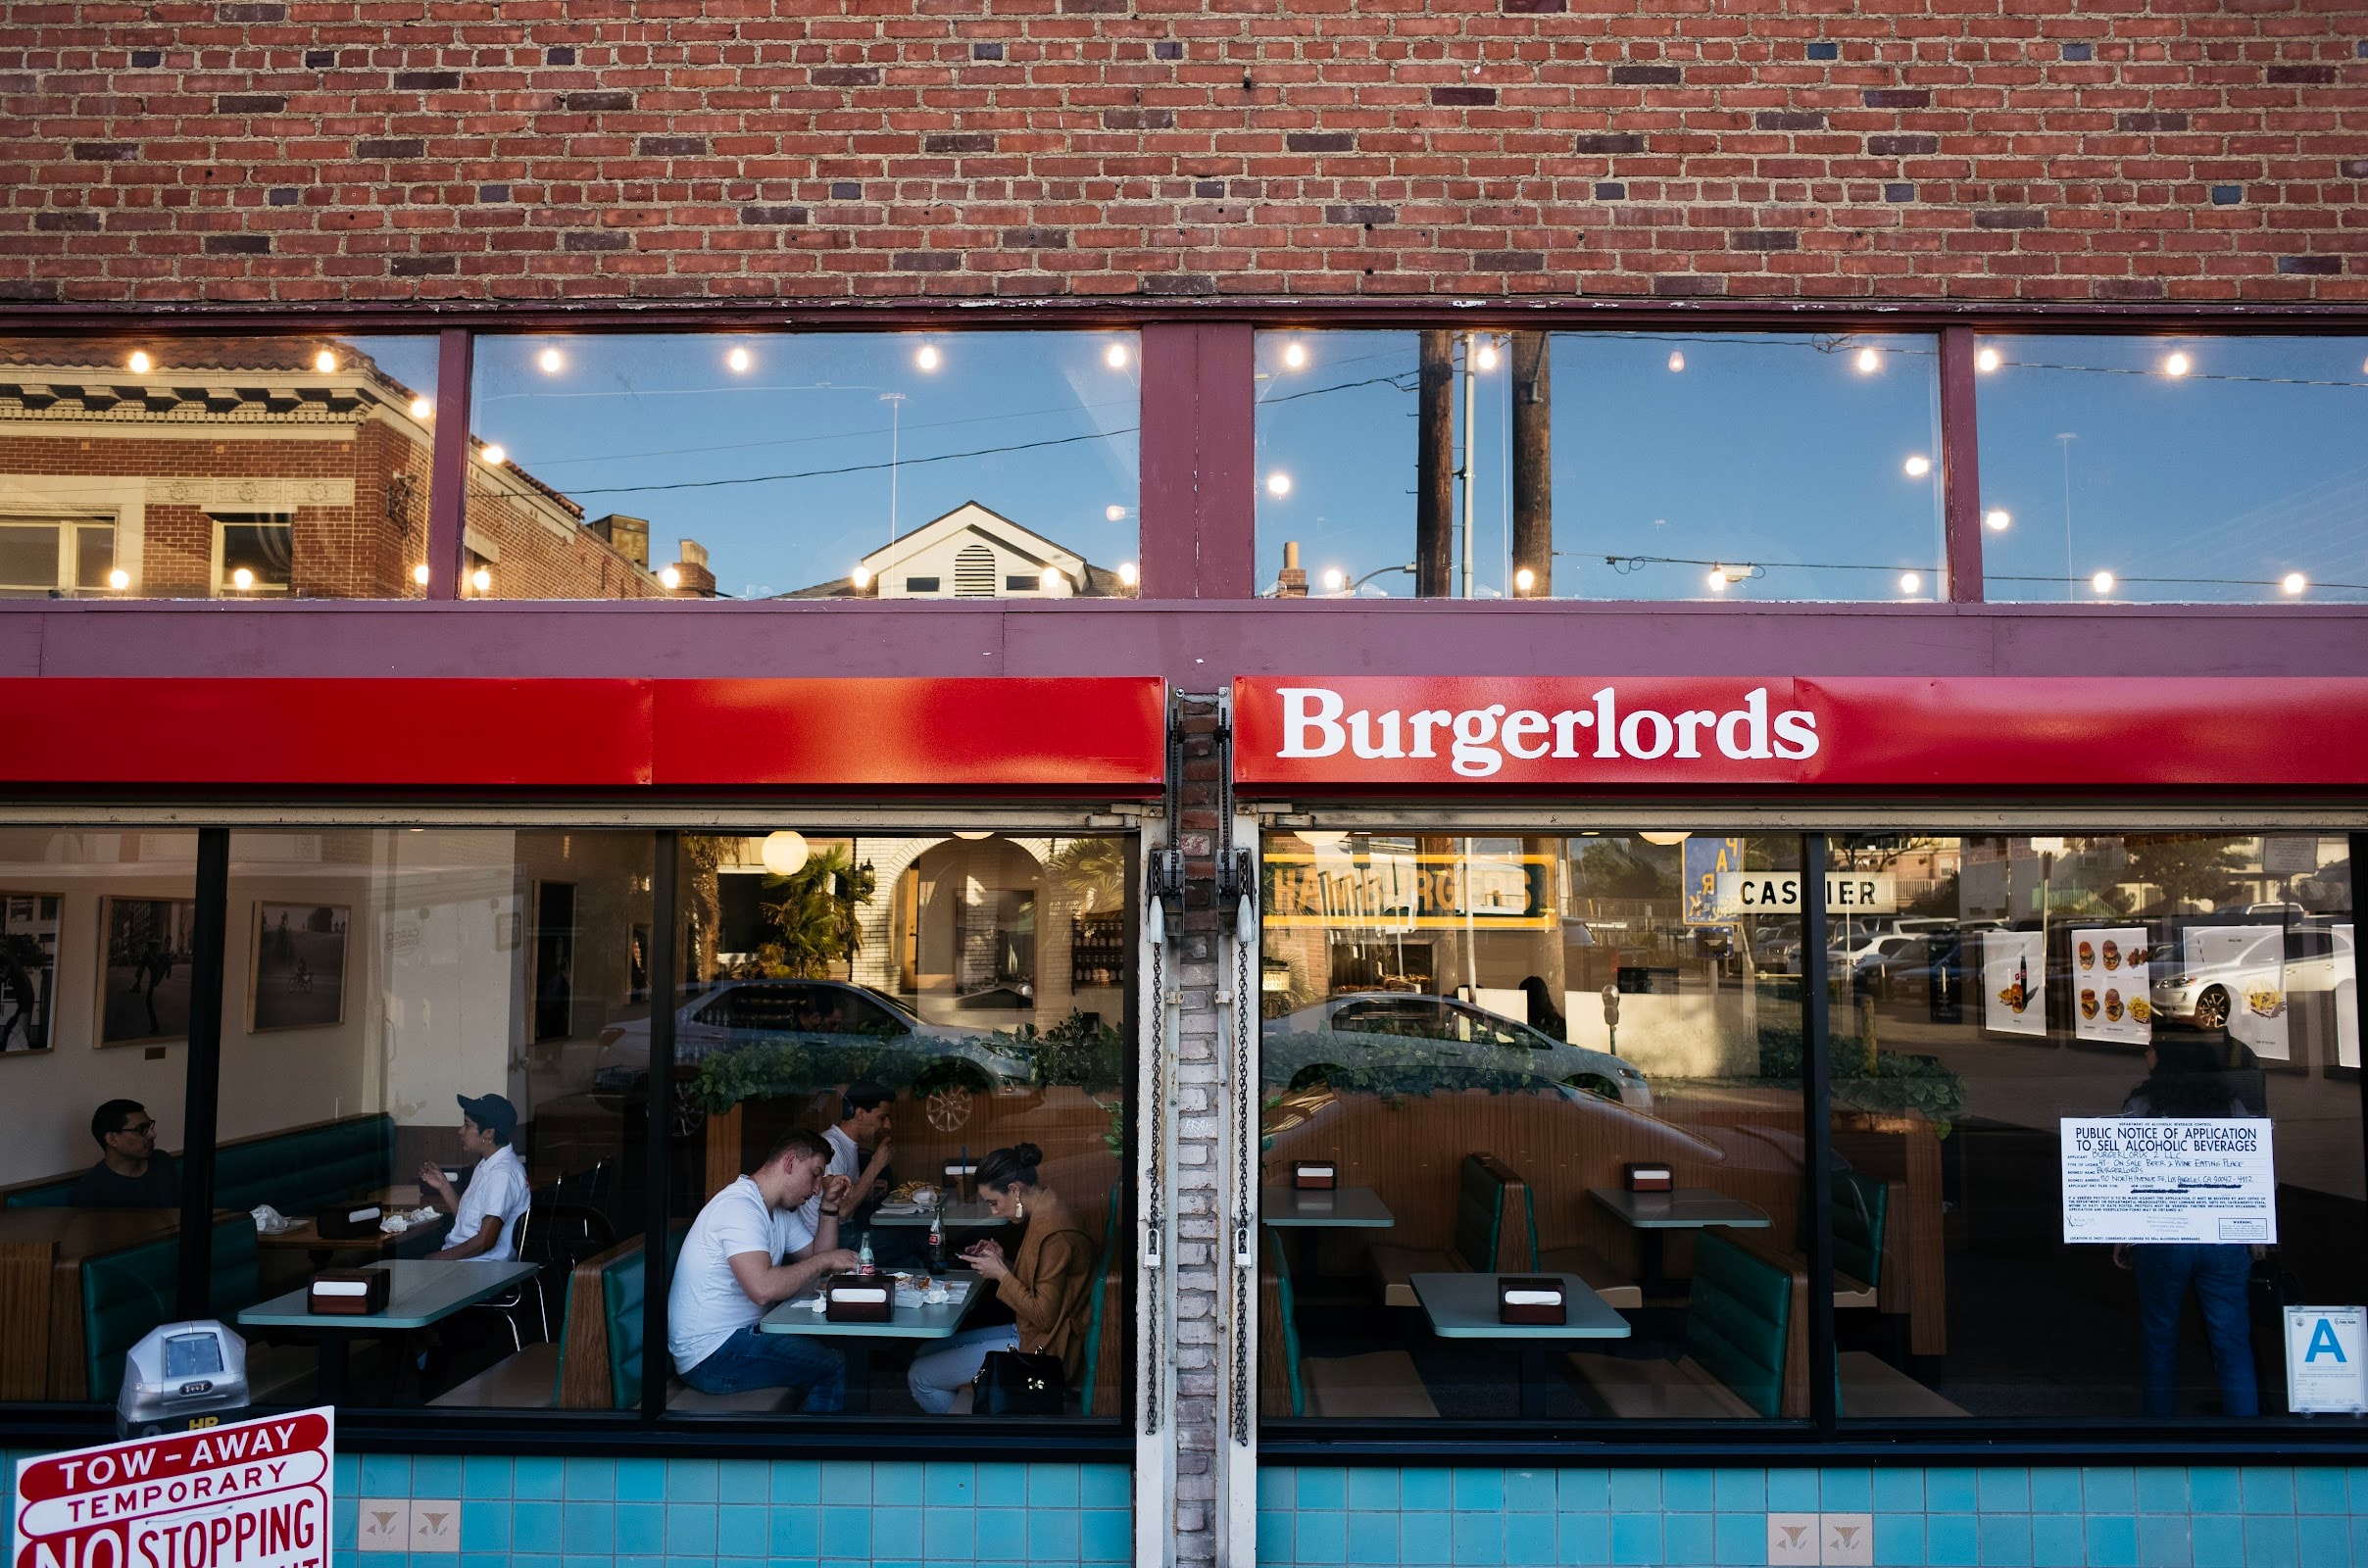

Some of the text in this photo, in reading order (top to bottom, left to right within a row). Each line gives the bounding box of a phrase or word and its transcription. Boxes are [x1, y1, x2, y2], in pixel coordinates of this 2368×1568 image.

[1276, 687, 1819, 777] Burgerlords
[1741, 880, 1876, 906] CASIER
[2076, 1127, 2256, 1139] PUBLIC NOTICE OF APPLICATION
[2076, 1140, 2257, 1152] TO SELL ALCOHOLIC BEVERAGES
[2305, 1319, 2347, 1363] A
[68, 1461, 287, 1523] TEMPORARY
[35, 1498, 315, 1568] NO STOPPING
